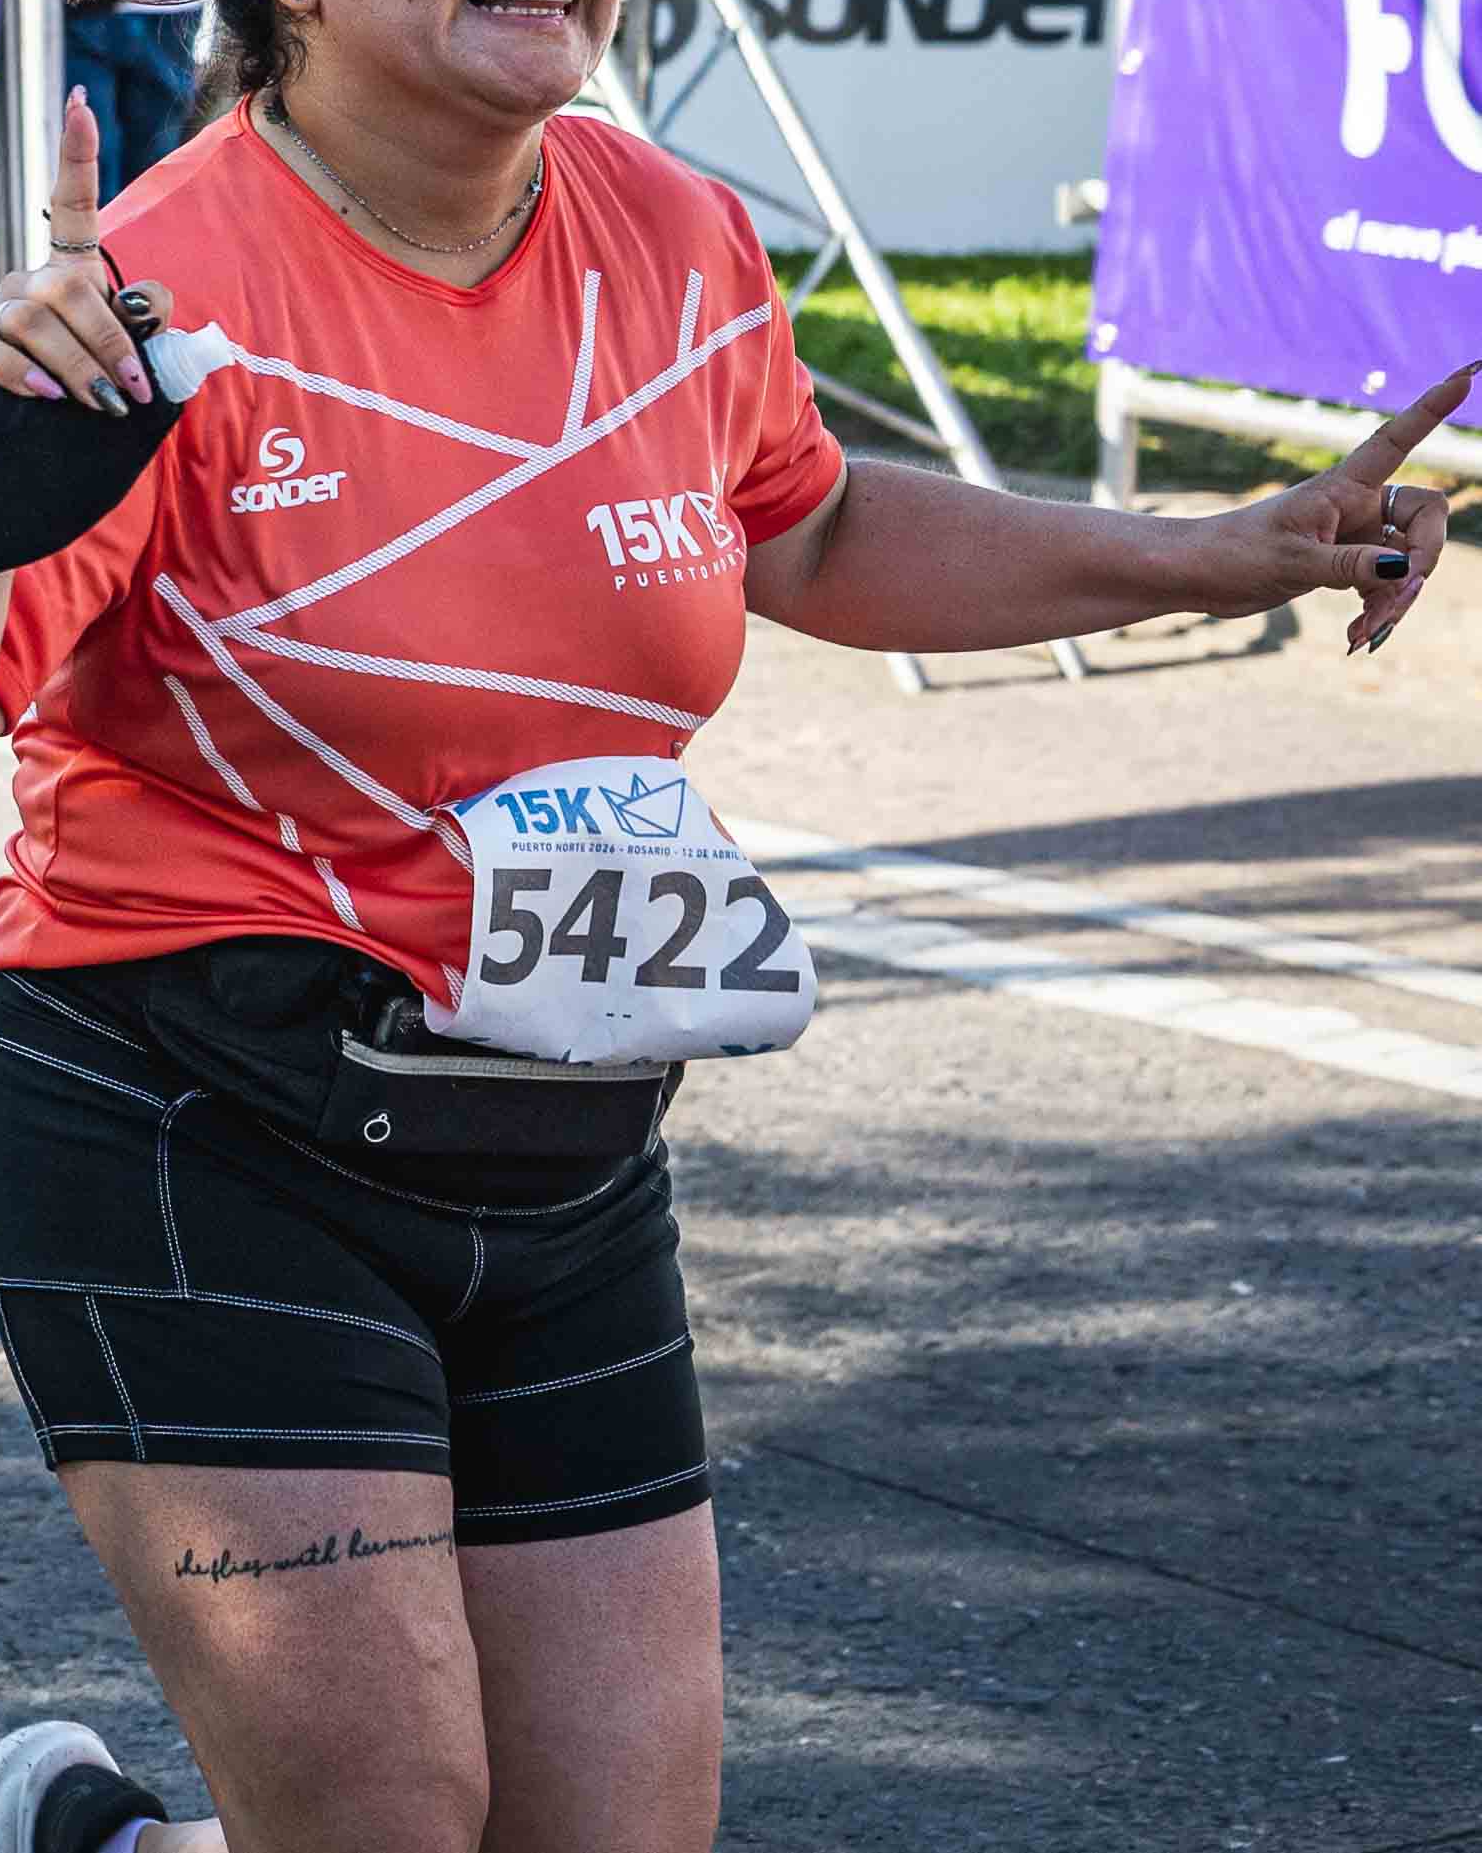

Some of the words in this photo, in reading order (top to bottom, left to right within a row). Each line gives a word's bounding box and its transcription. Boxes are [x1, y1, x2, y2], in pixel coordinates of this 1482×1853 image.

[586, 492, 704, 567] 15K
[614, 566, 709, 591] PUERTO
[495, 786, 602, 835] 15K
[511, 841, 552, 853] PUERTO
[555, 843, 586, 853] NORTE
[589, 844, 615, 854] 2026
[626, 845, 671, 857] ROSARIO
[682, 848, 693, 858] 12
[696, 848, 708, 859] DE
[479, 868, 800, 994] 5422
